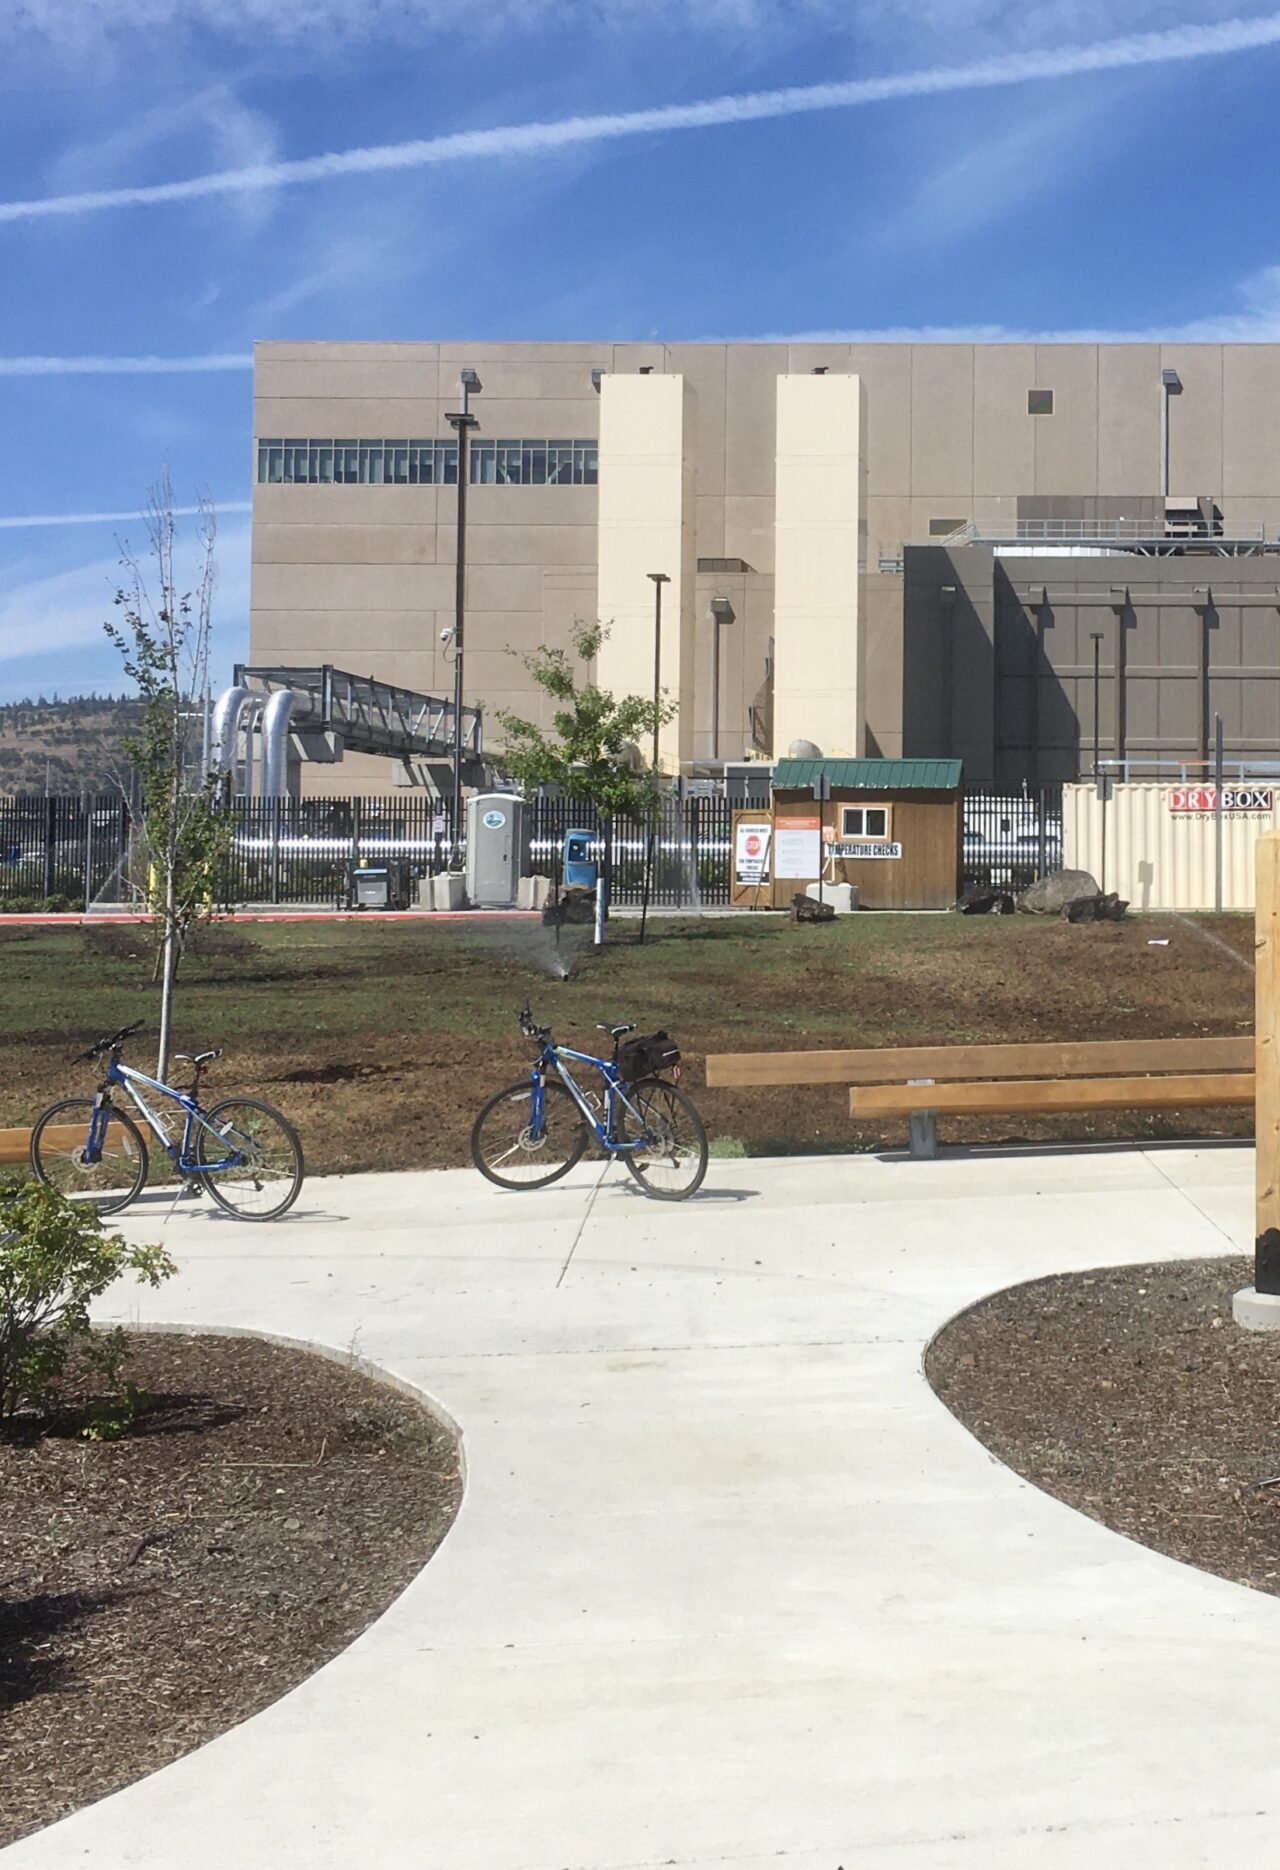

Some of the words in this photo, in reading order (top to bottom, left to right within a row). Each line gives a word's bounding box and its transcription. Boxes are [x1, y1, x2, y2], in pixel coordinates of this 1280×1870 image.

[1169, 791, 1268, 808] DRYBOX
[1171, 813, 1271, 821] www.DryBxUSA.com
[873, 844, 898, 856] CHECKS
